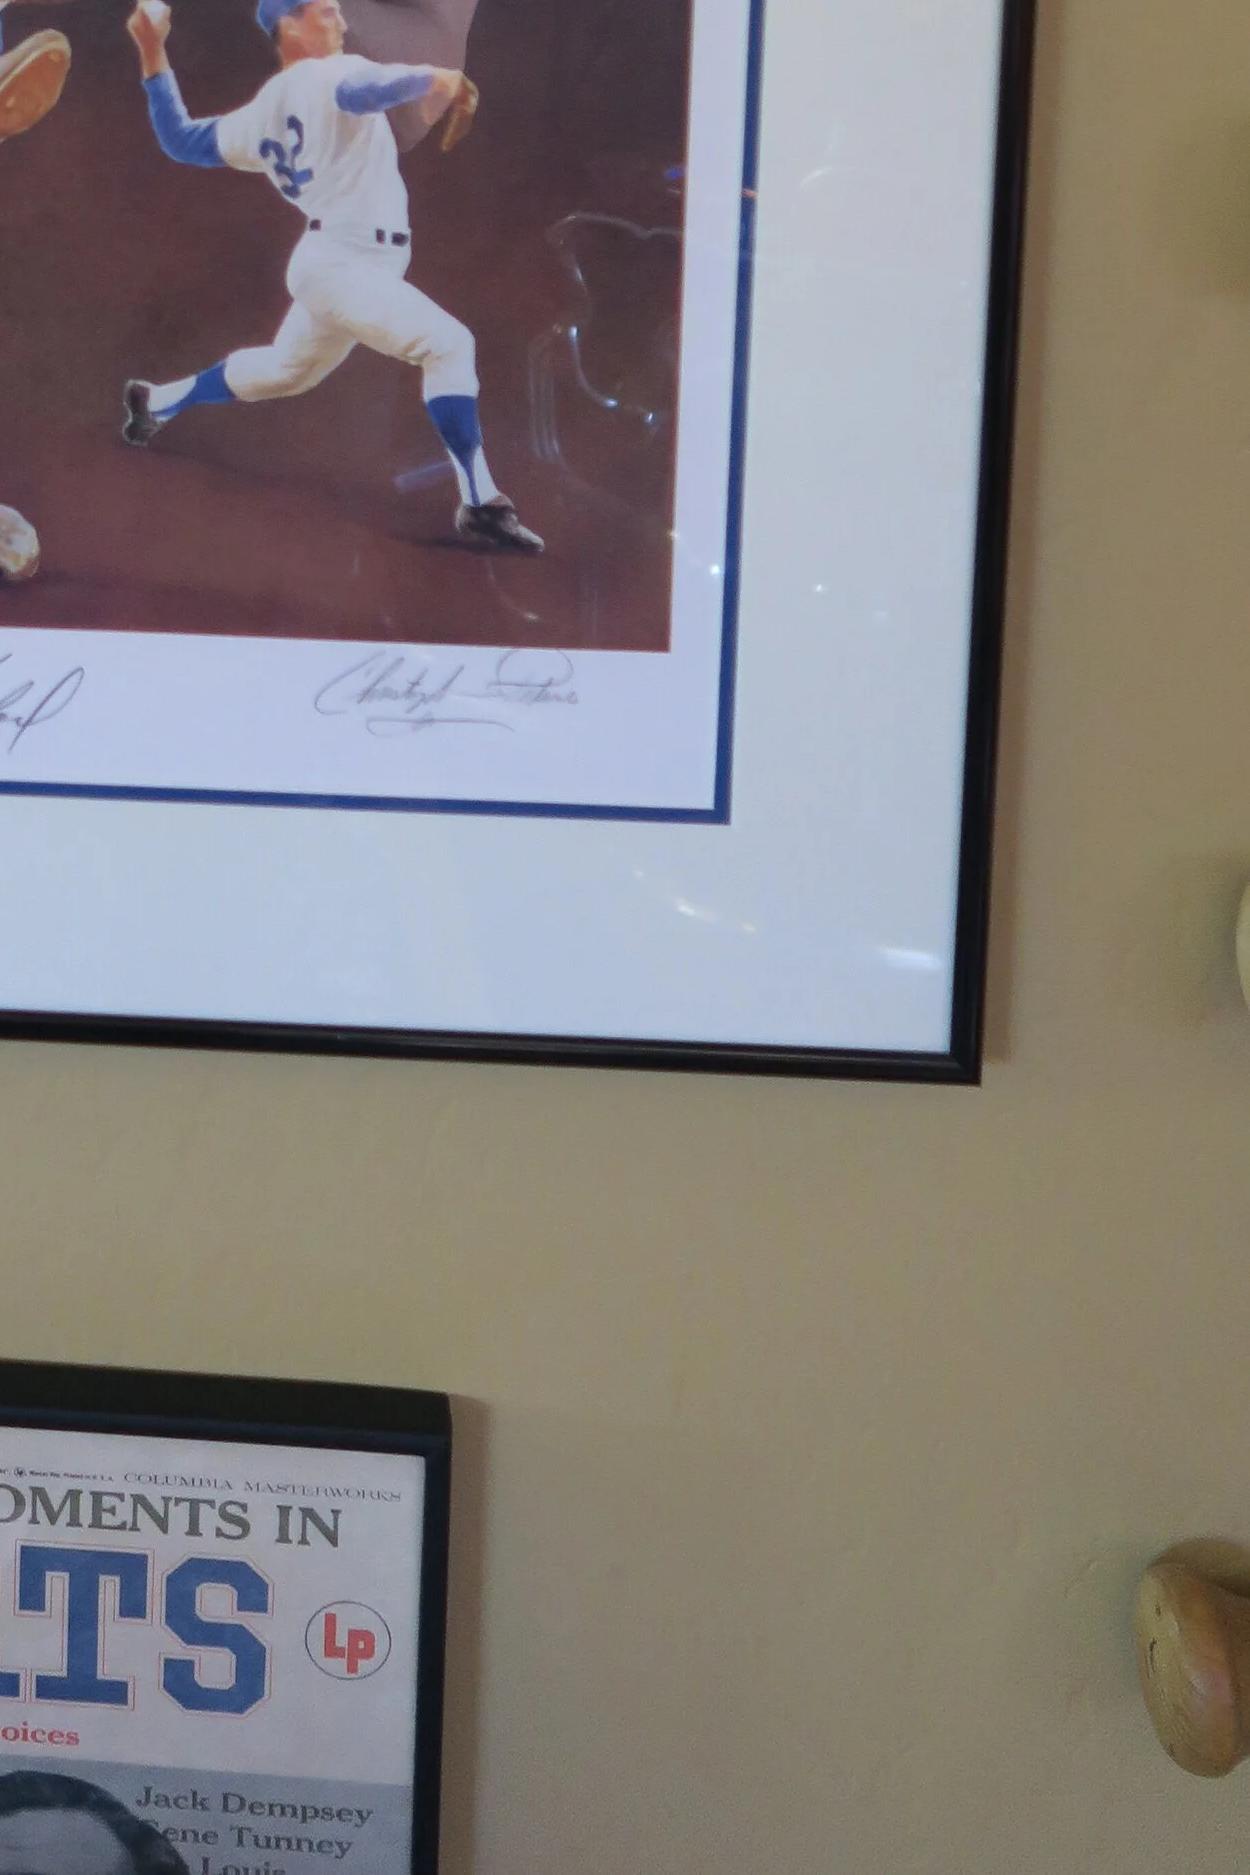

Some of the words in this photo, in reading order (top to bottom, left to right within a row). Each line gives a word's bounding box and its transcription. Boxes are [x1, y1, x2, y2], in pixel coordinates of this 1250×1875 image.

[124, 1472, 234, 1490] COLUMBIA
[244, 1479, 401, 1502] MASTERWORKS
[275, 1504, 342, 1548] IN
[135, 1785, 209, 1812] Jack
[221, 1791, 374, 1827] Dempsey
[148, 1818, 220, 1845] ene
[230, 1826, 354, 1859] Tunney
